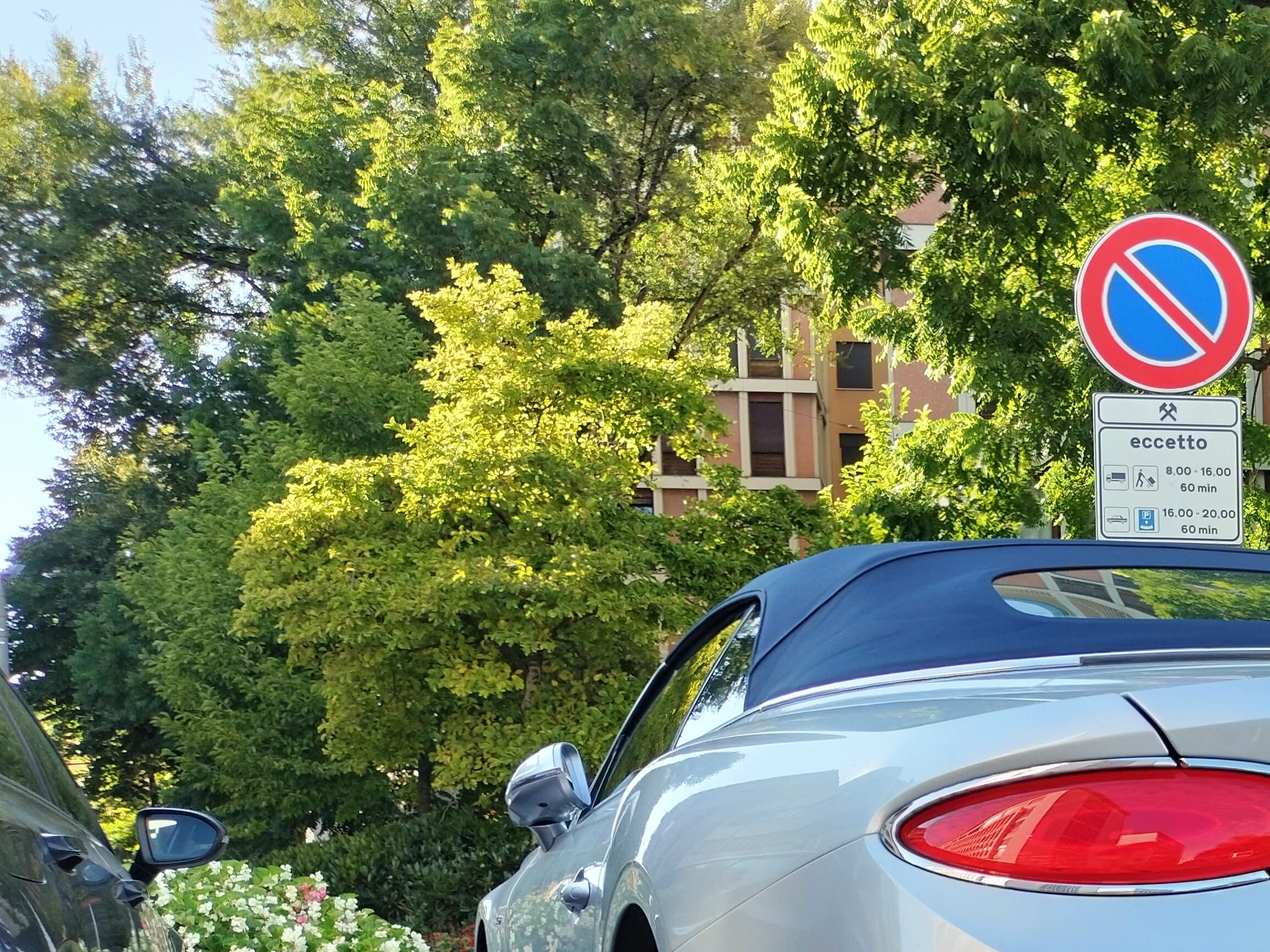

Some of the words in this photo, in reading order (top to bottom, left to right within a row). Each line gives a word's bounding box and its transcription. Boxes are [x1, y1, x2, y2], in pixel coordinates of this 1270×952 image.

[1130, 435, 1208, 450] eccetto
[1165, 466, 1191, 476] 8.00
[1201, 467, 1231, 477] 16.00
[1180, 483, 1195, 493] 60
[1197, 483, 1217, 493] min
[1162, 508, 1193, 518] 16.00
[1202, 509, 1236, 519] 20.00
[1181, 525, 1196, 535] 60
[1198, 525, 1218, 535] min
